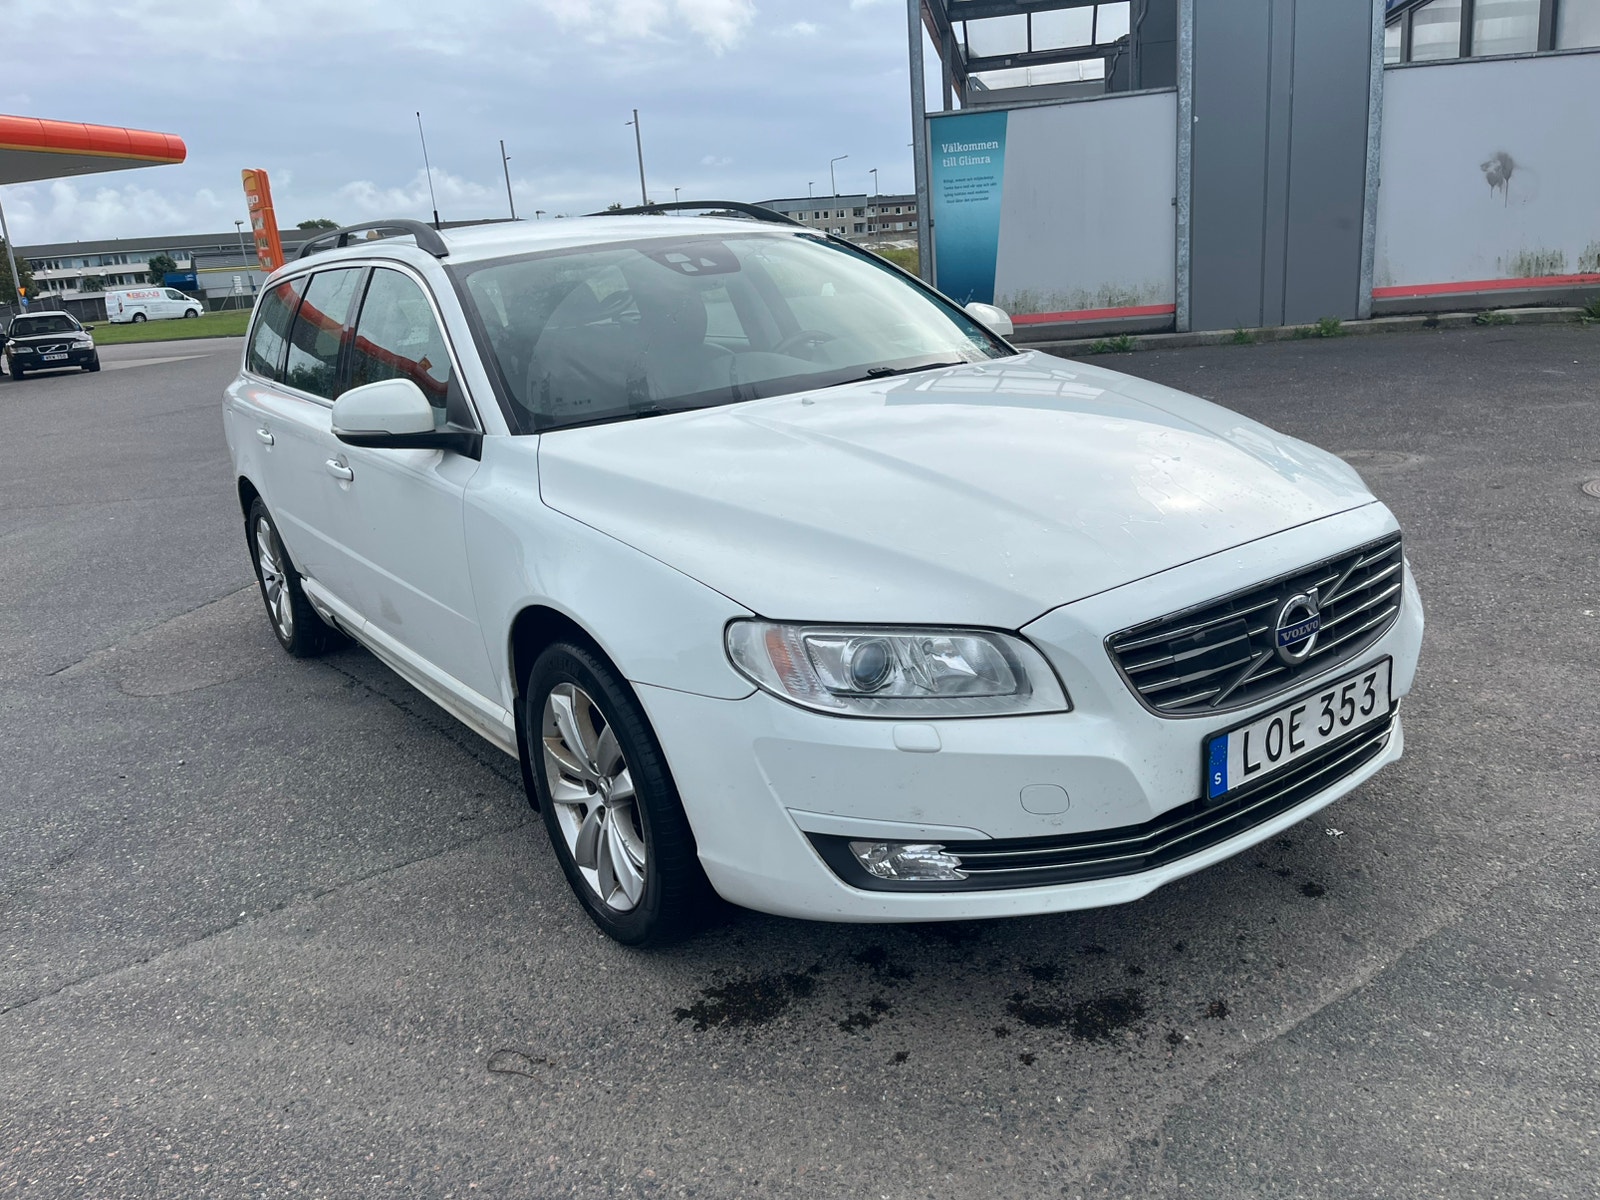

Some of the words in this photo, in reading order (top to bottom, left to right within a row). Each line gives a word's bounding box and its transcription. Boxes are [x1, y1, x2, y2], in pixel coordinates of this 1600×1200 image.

[942, 141, 999, 153] Välkommen
[943, 156, 957, 168] till
[959, 155, 991, 166] Glimra
[1281, 620, 1319, 641] VOLVO
[1243, 705, 1306, 776] LOE
[1318, 672, 1377, 736] 353
[1214, 772, 1222, 785] S
